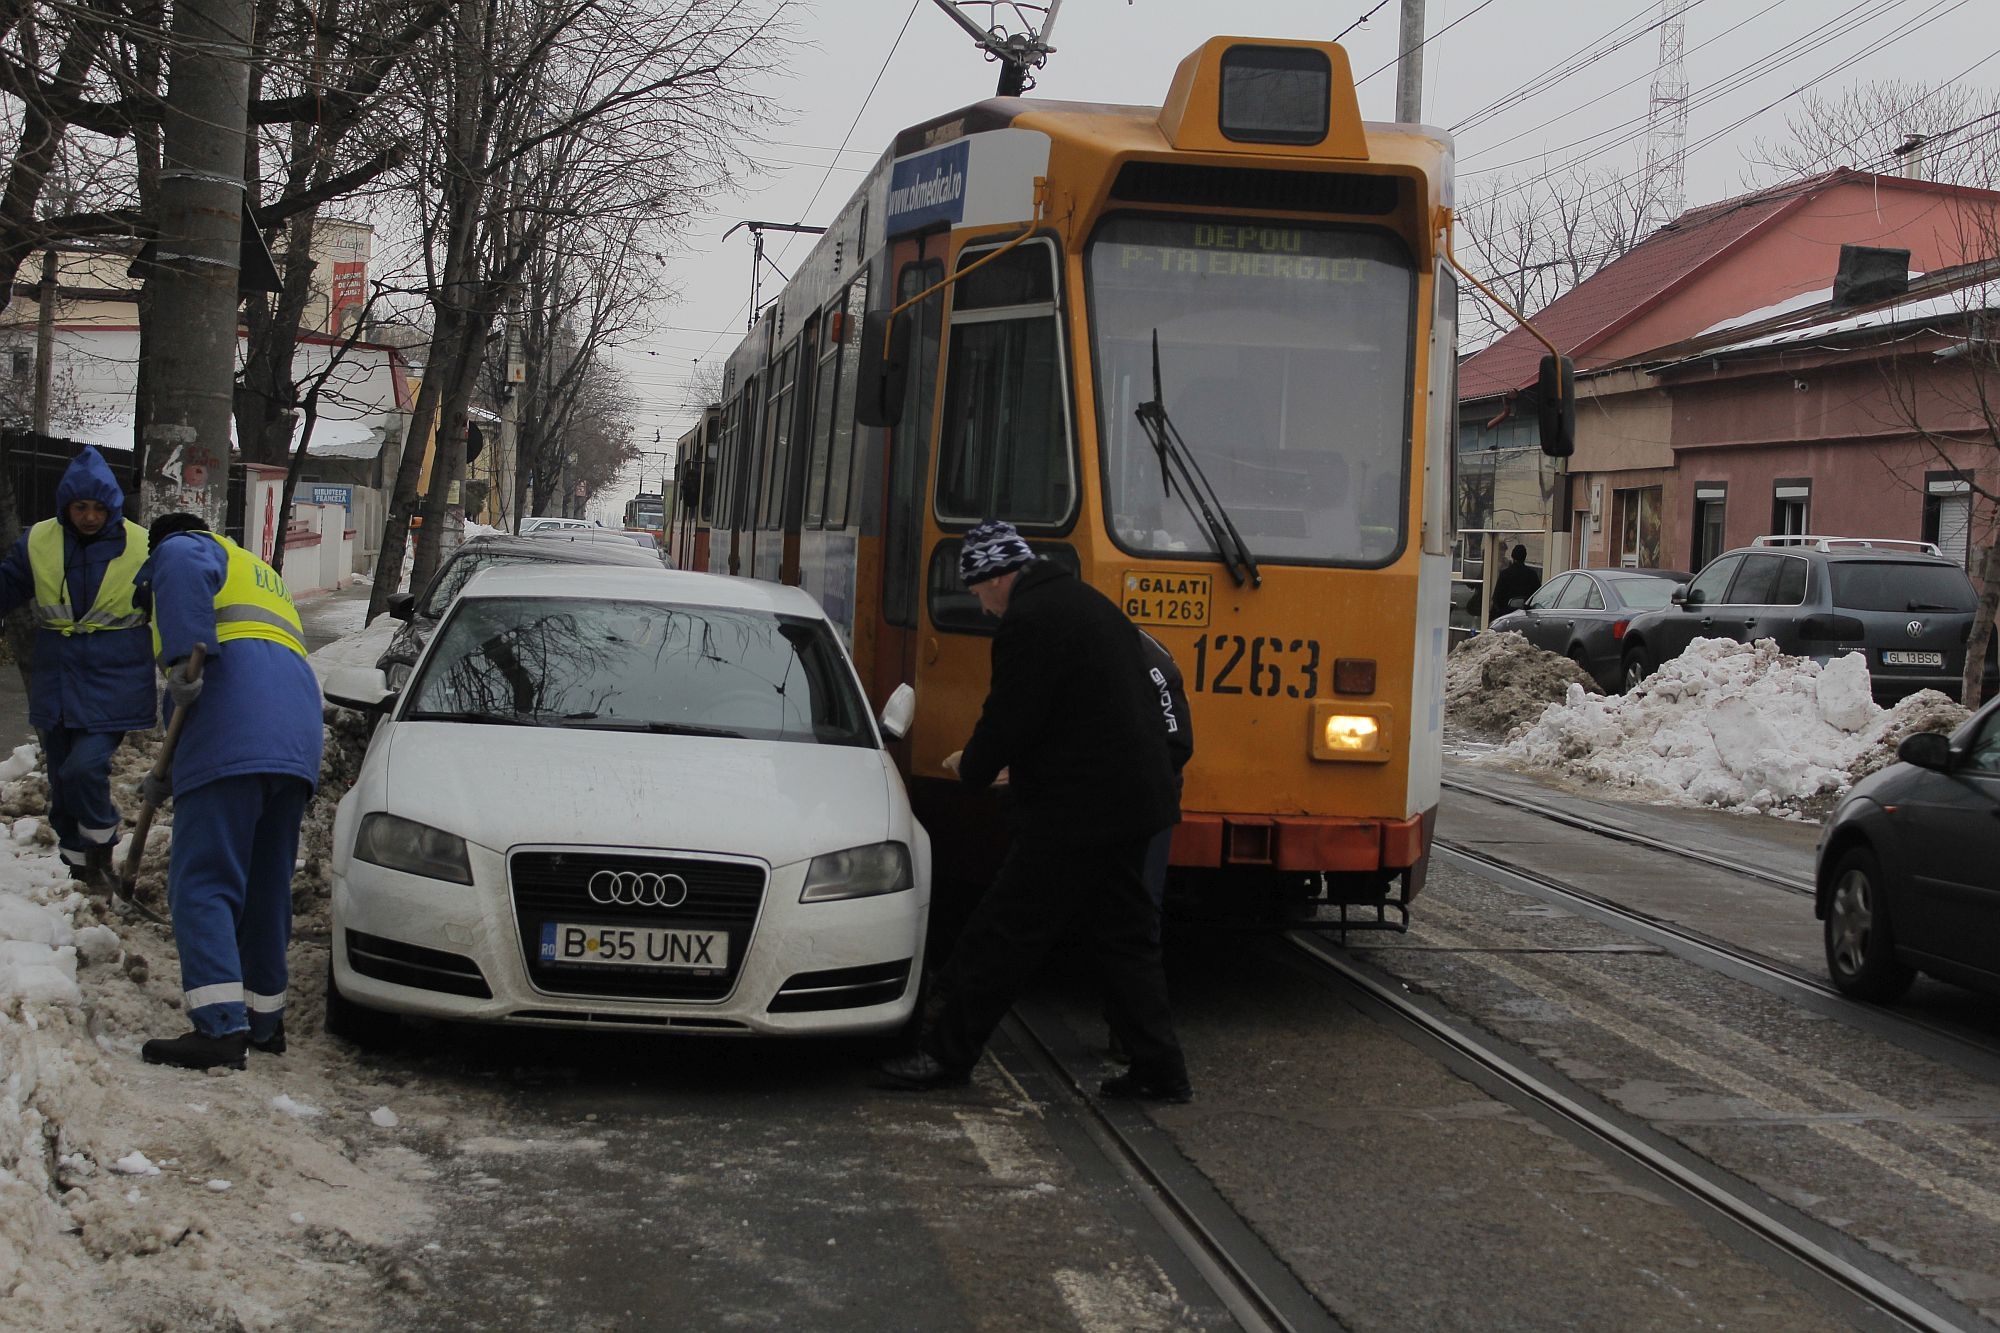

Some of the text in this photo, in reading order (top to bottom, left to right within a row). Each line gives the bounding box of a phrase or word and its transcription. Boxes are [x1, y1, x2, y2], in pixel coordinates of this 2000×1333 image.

[889, 163, 962, 216] www.okmedical.ro
[1194, 223, 1300, 251] DEPOU
[1121, 247, 1368, 282] P-TA ENERGIEI
[314, 488, 347, 496] BIBLIOTECA
[1139, 578, 1207, 595] GALATI
[1193, 633, 1321, 699] 1263
[1889, 653, 1939, 664] GL 13 BSC
[1149, 667, 1178, 733] GIVOVA
[564, 927, 714, 964] B 55 UNX
